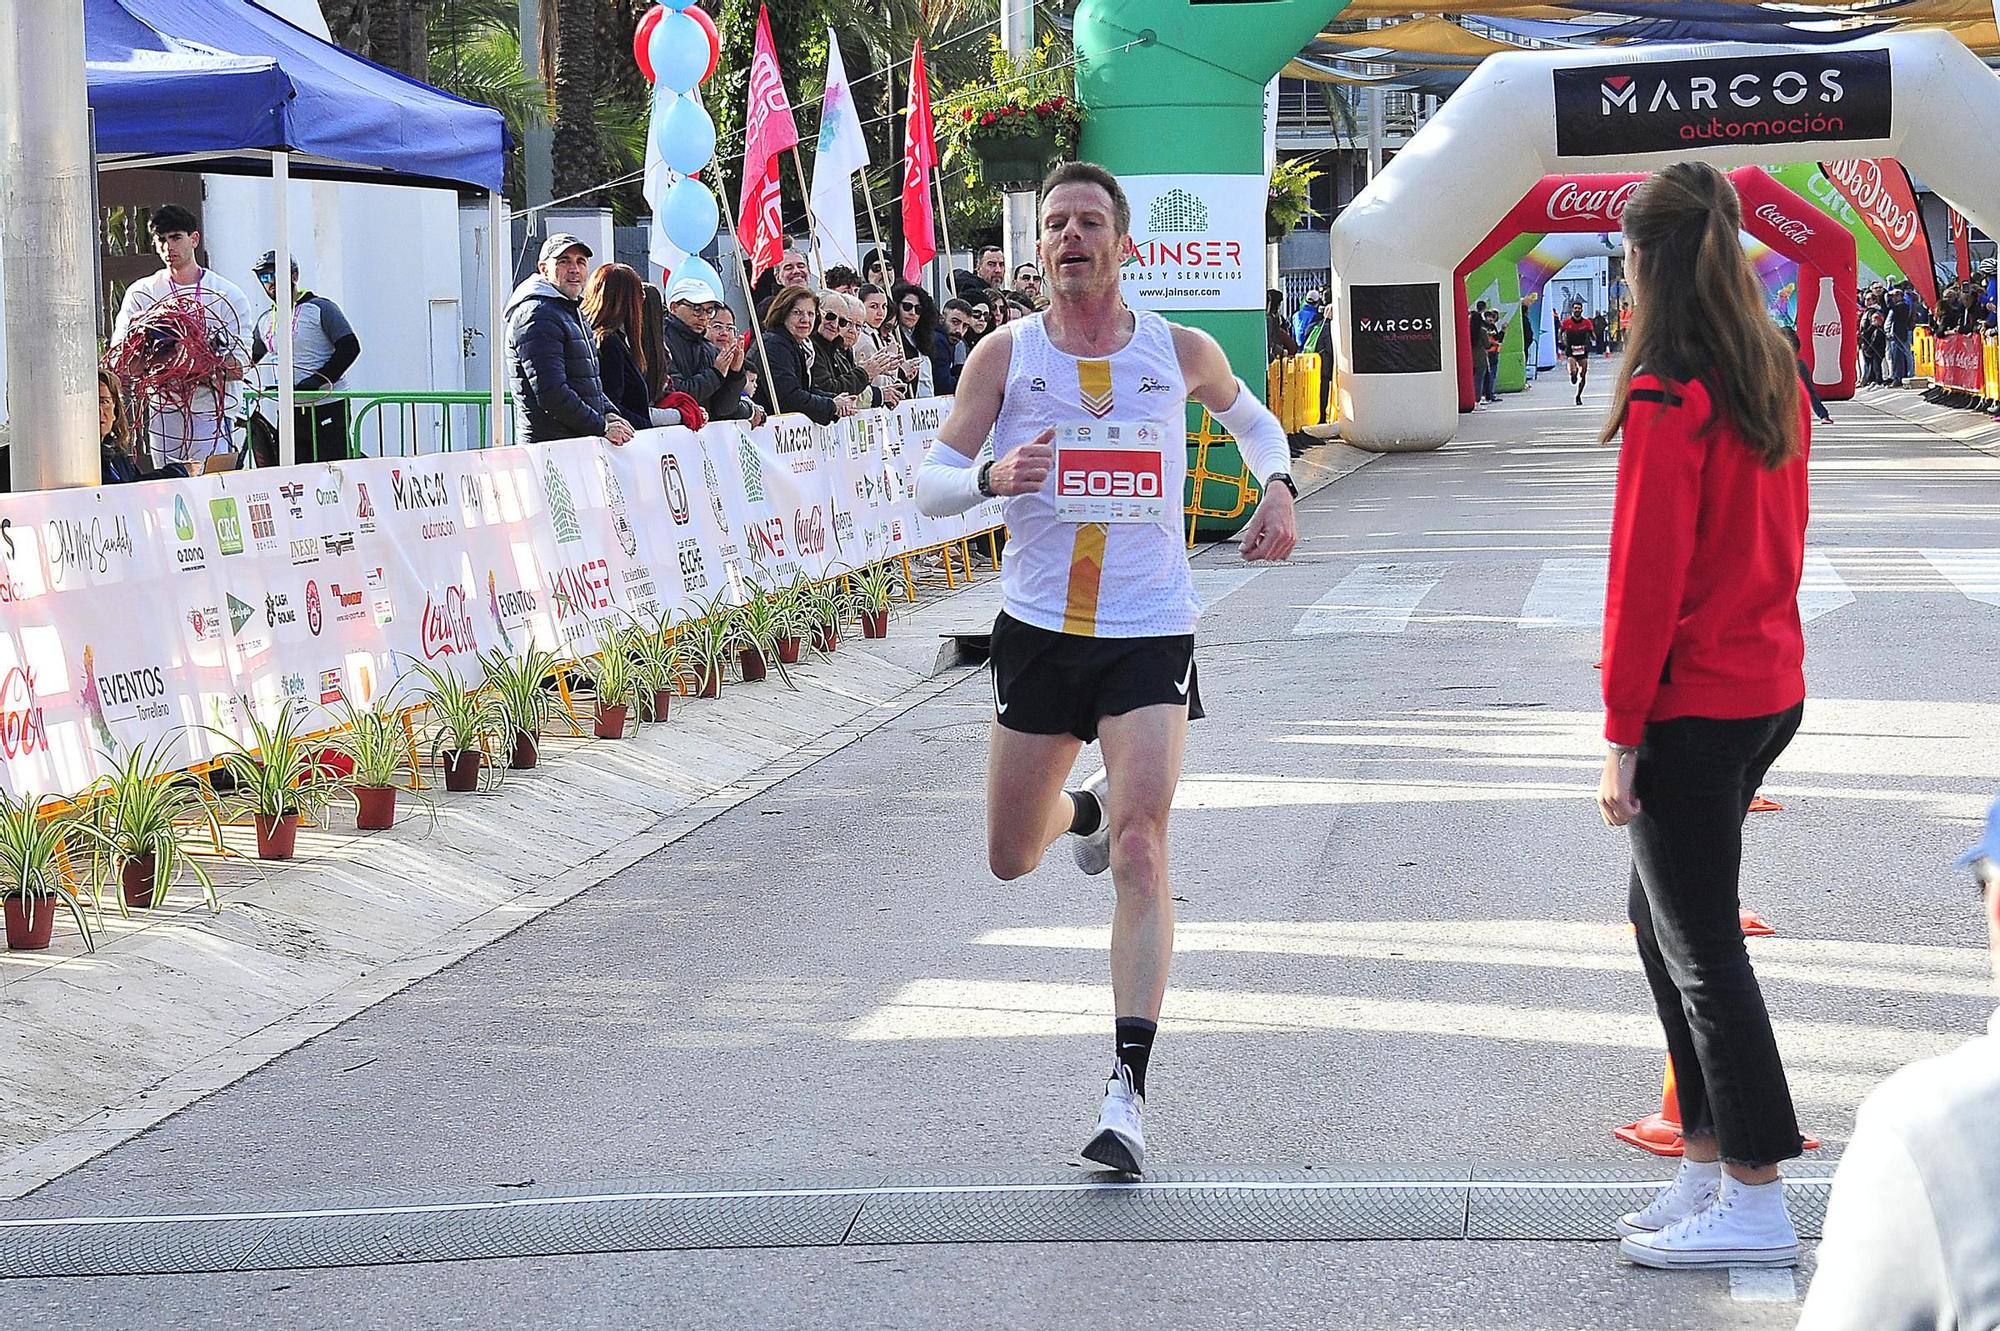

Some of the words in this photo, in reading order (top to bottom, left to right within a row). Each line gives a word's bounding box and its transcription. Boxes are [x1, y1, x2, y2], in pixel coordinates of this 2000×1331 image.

[1601, 69, 1844, 115] MARCOS
[1680, 112, 1844, 140] automoción
[1755, 203, 1817, 246] Coca-Cola
[1130, 241, 1241, 268] AINSER
[1122, 272, 1153, 281] BRAS
[1162, 272, 1168, 280] Y
[1177, 271, 1242, 280] SERVICIOS
[1360, 317, 1433, 332] MARCOS
[775, 425, 813, 455] MARCOS
[391, 469, 448, 511] MARCOS
[1062, 470, 1158, 497] 5030
[217, 516, 240, 541] CRC
[498, 590, 537, 618] EVENTOS
[98, 666, 165, 707] EVENTOS
[136, 702, 170, 722] Torrellano
